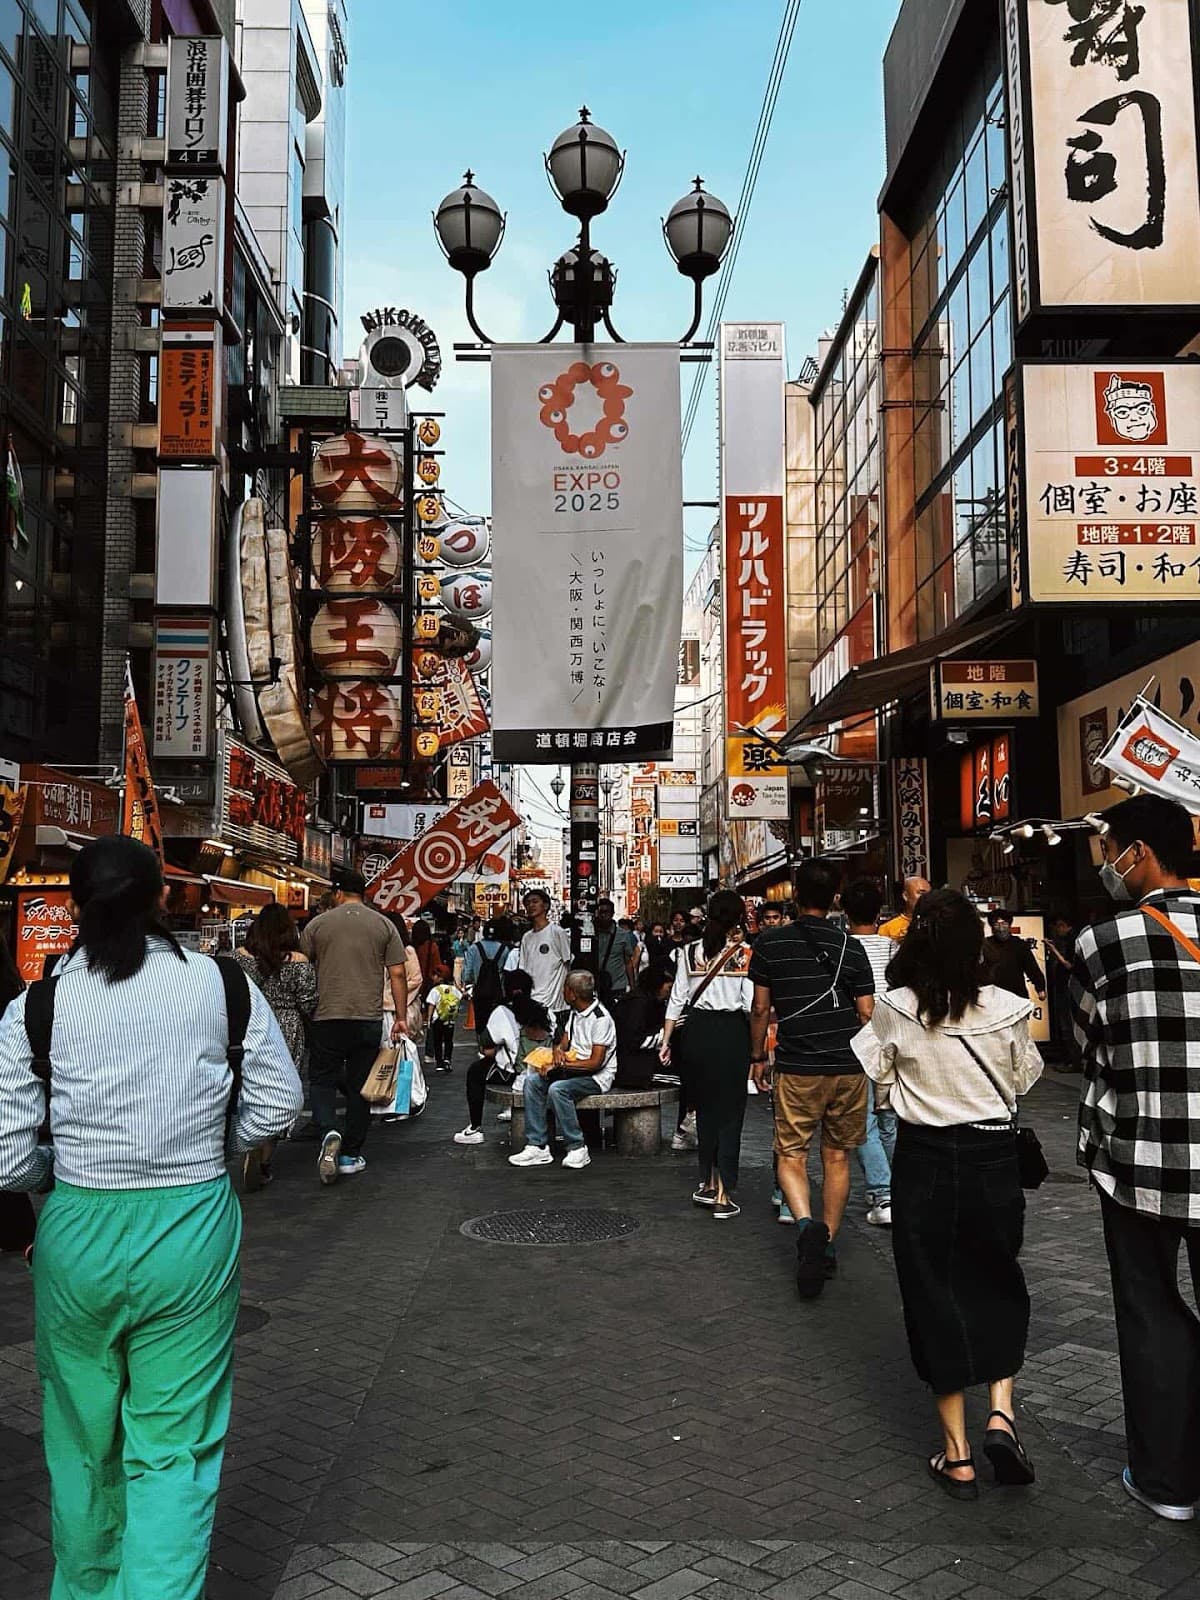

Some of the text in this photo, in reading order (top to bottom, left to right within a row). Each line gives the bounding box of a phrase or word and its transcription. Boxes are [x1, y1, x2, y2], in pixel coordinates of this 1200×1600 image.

[185, 40, 207, 148] 浪花囲碁サロン
[1006, 0, 1029, 312] 6212)1705
[166, 234, 213, 275] Leaf
[179, 352, 196, 435] ミティラー
[1104, 457, 1166, 475] 3・4階
[553, 471, 621, 492] EXPO
[554, 493, 621, 512] 2025
[1039, 482, 1199, 516] 個室・お座
[1081, 525, 1191, 544] 地階・1・2階
[738, 502, 772, 702] ツルハドラッグ
[967, 665, 1006, 681] 地階
[176, 659, 190, 731] クンテープ
[944, 689, 1033, 710] 個室・和食
[535, 731, 637, 749] 道頓堀商店会
[826, 768, 872, 782] ツルハ
